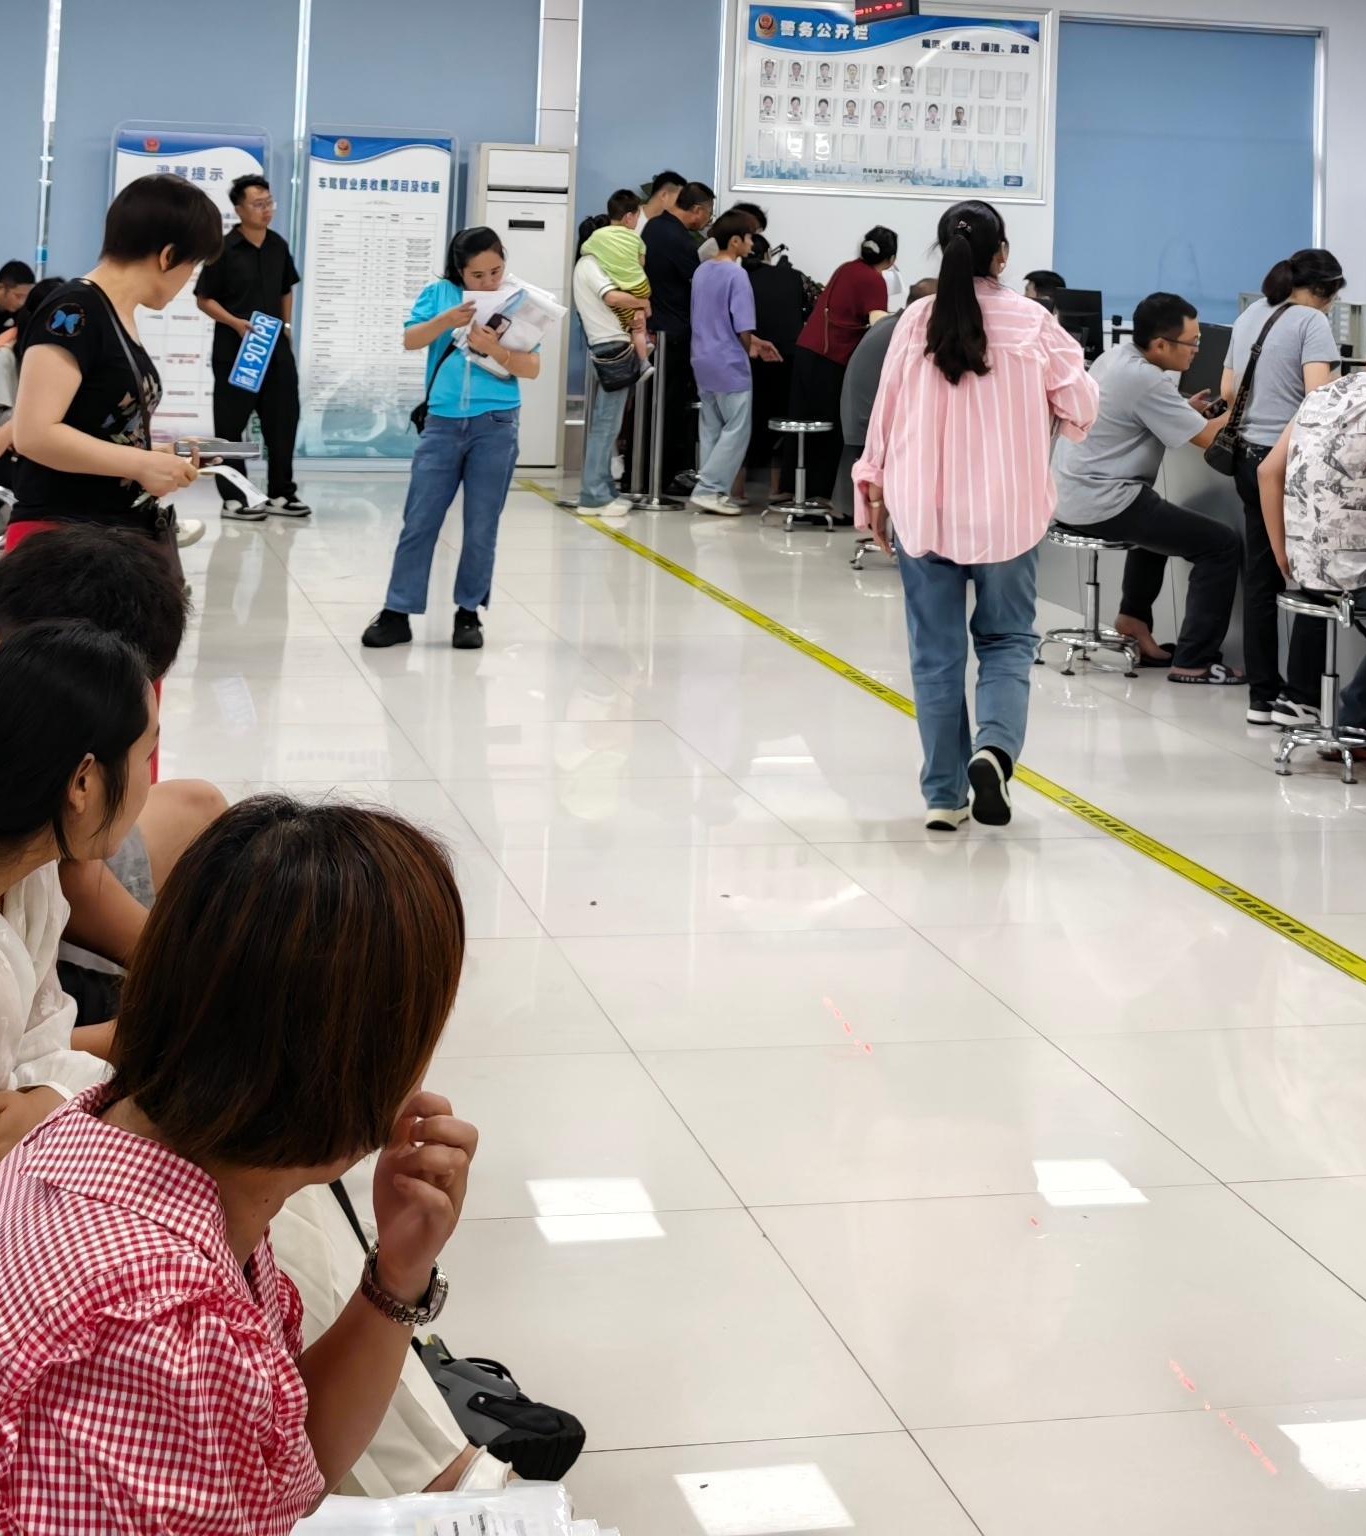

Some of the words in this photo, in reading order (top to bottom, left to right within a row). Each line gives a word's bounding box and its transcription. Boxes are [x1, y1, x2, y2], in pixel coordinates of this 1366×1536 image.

[779, 19, 869, 42] 警务公开栏
